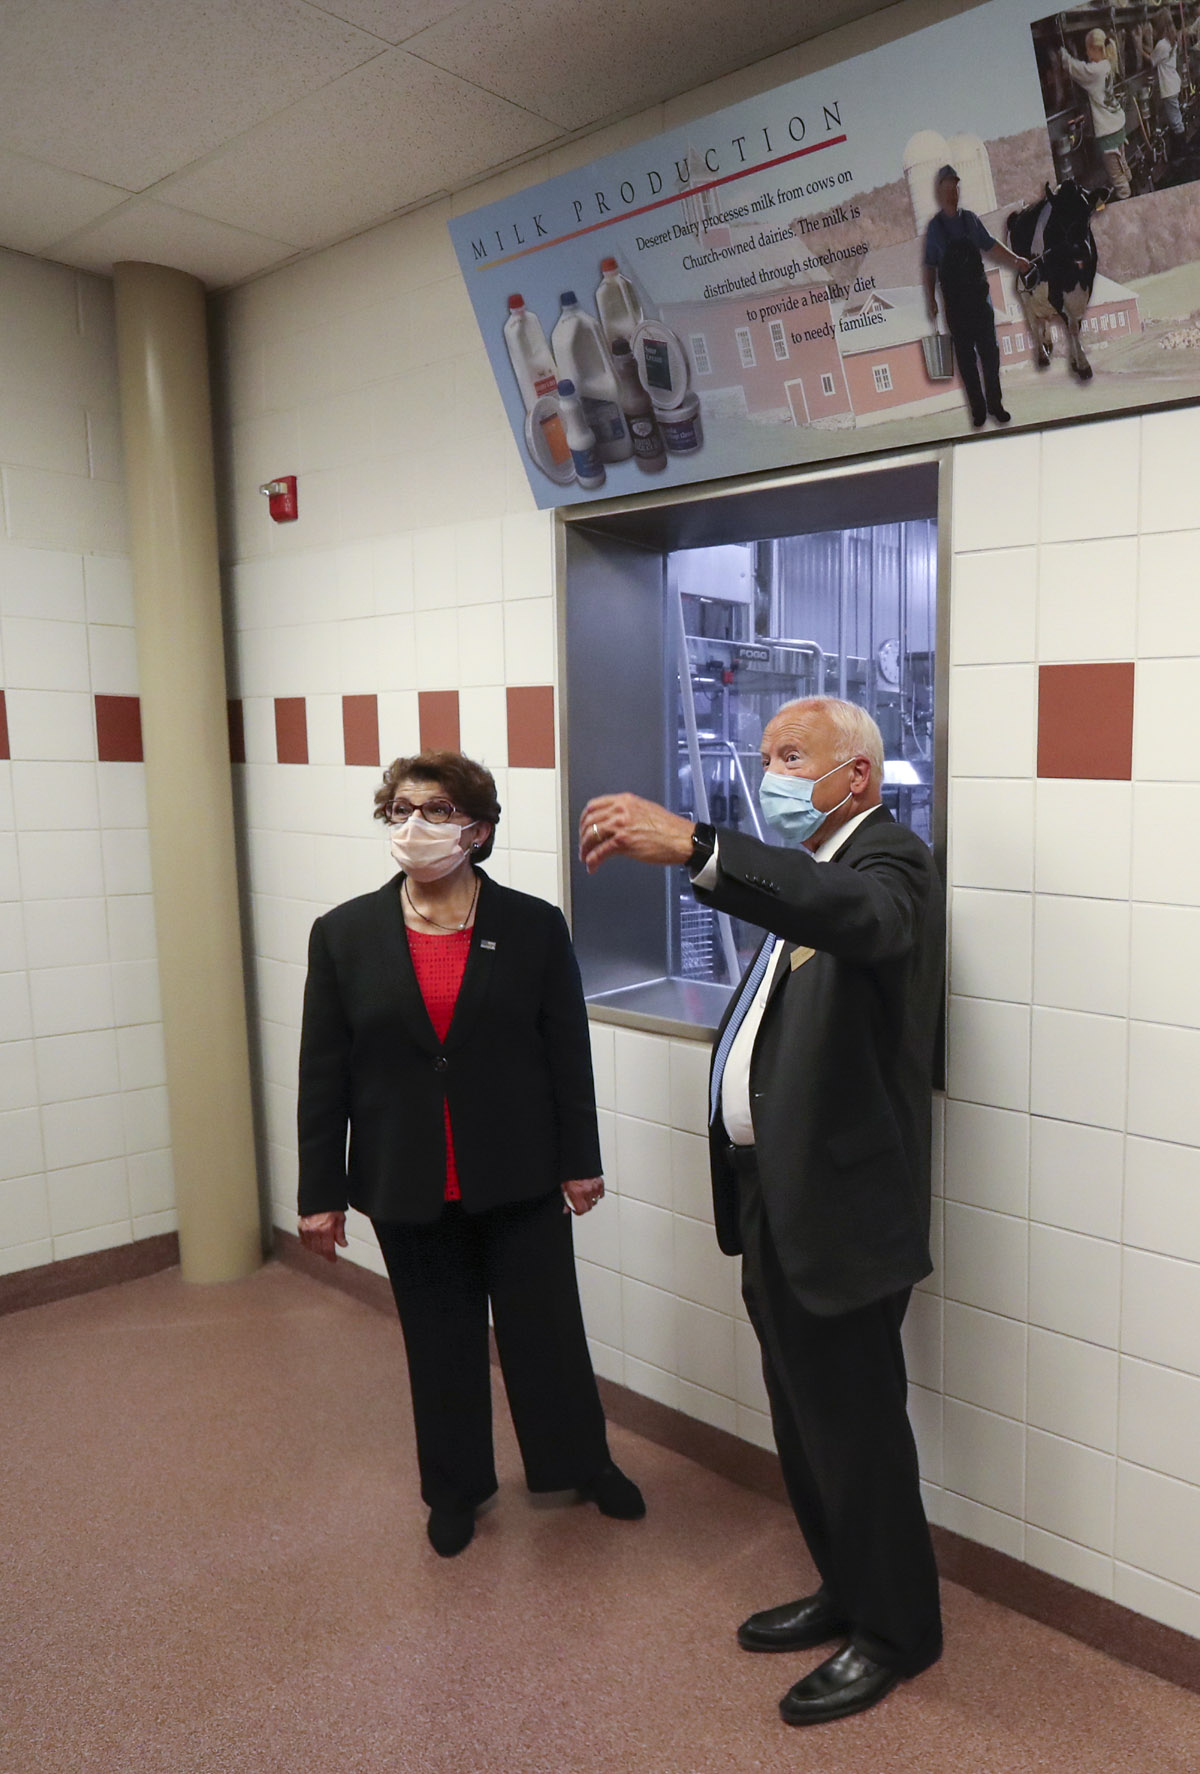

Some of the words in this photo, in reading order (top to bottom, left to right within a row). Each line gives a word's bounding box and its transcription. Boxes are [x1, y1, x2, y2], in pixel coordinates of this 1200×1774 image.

[471, 214, 548, 261] MILK
[572, 101, 843, 223] PRODUCTION
[635, 230, 672, 251] Deseret
[672, 221, 700, 238] Dairy
[702, 205, 749, 229] processes
[751, 192, 776, 213] milk
[777, 186, 804, 205] from
[805, 176, 836, 195] cows
[837, 169, 853, 186] on
[682, 236, 756, 271] Church-owned
[757, 227, 797, 249] dairies.
[797, 217, 820, 236] The
[822, 208, 849, 228] milk
[850, 204, 861, 221] is
[703, 272, 757, 300] distributed
[757, 261, 801, 287] through
[802, 241, 869, 271] storehouses
[746, 307, 758, 322] to
[758, 297, 800, 323] provide
[801, 295, 808, 308] a
[809, 284, 850, 306] healthy
[853, 274, 877, 294] diet
[791, 330, 802, 345] to
[803, 322, 836, 343] needy
[838, 311, 887, 334] families.
[739, 649, 768, 660] FOGG
